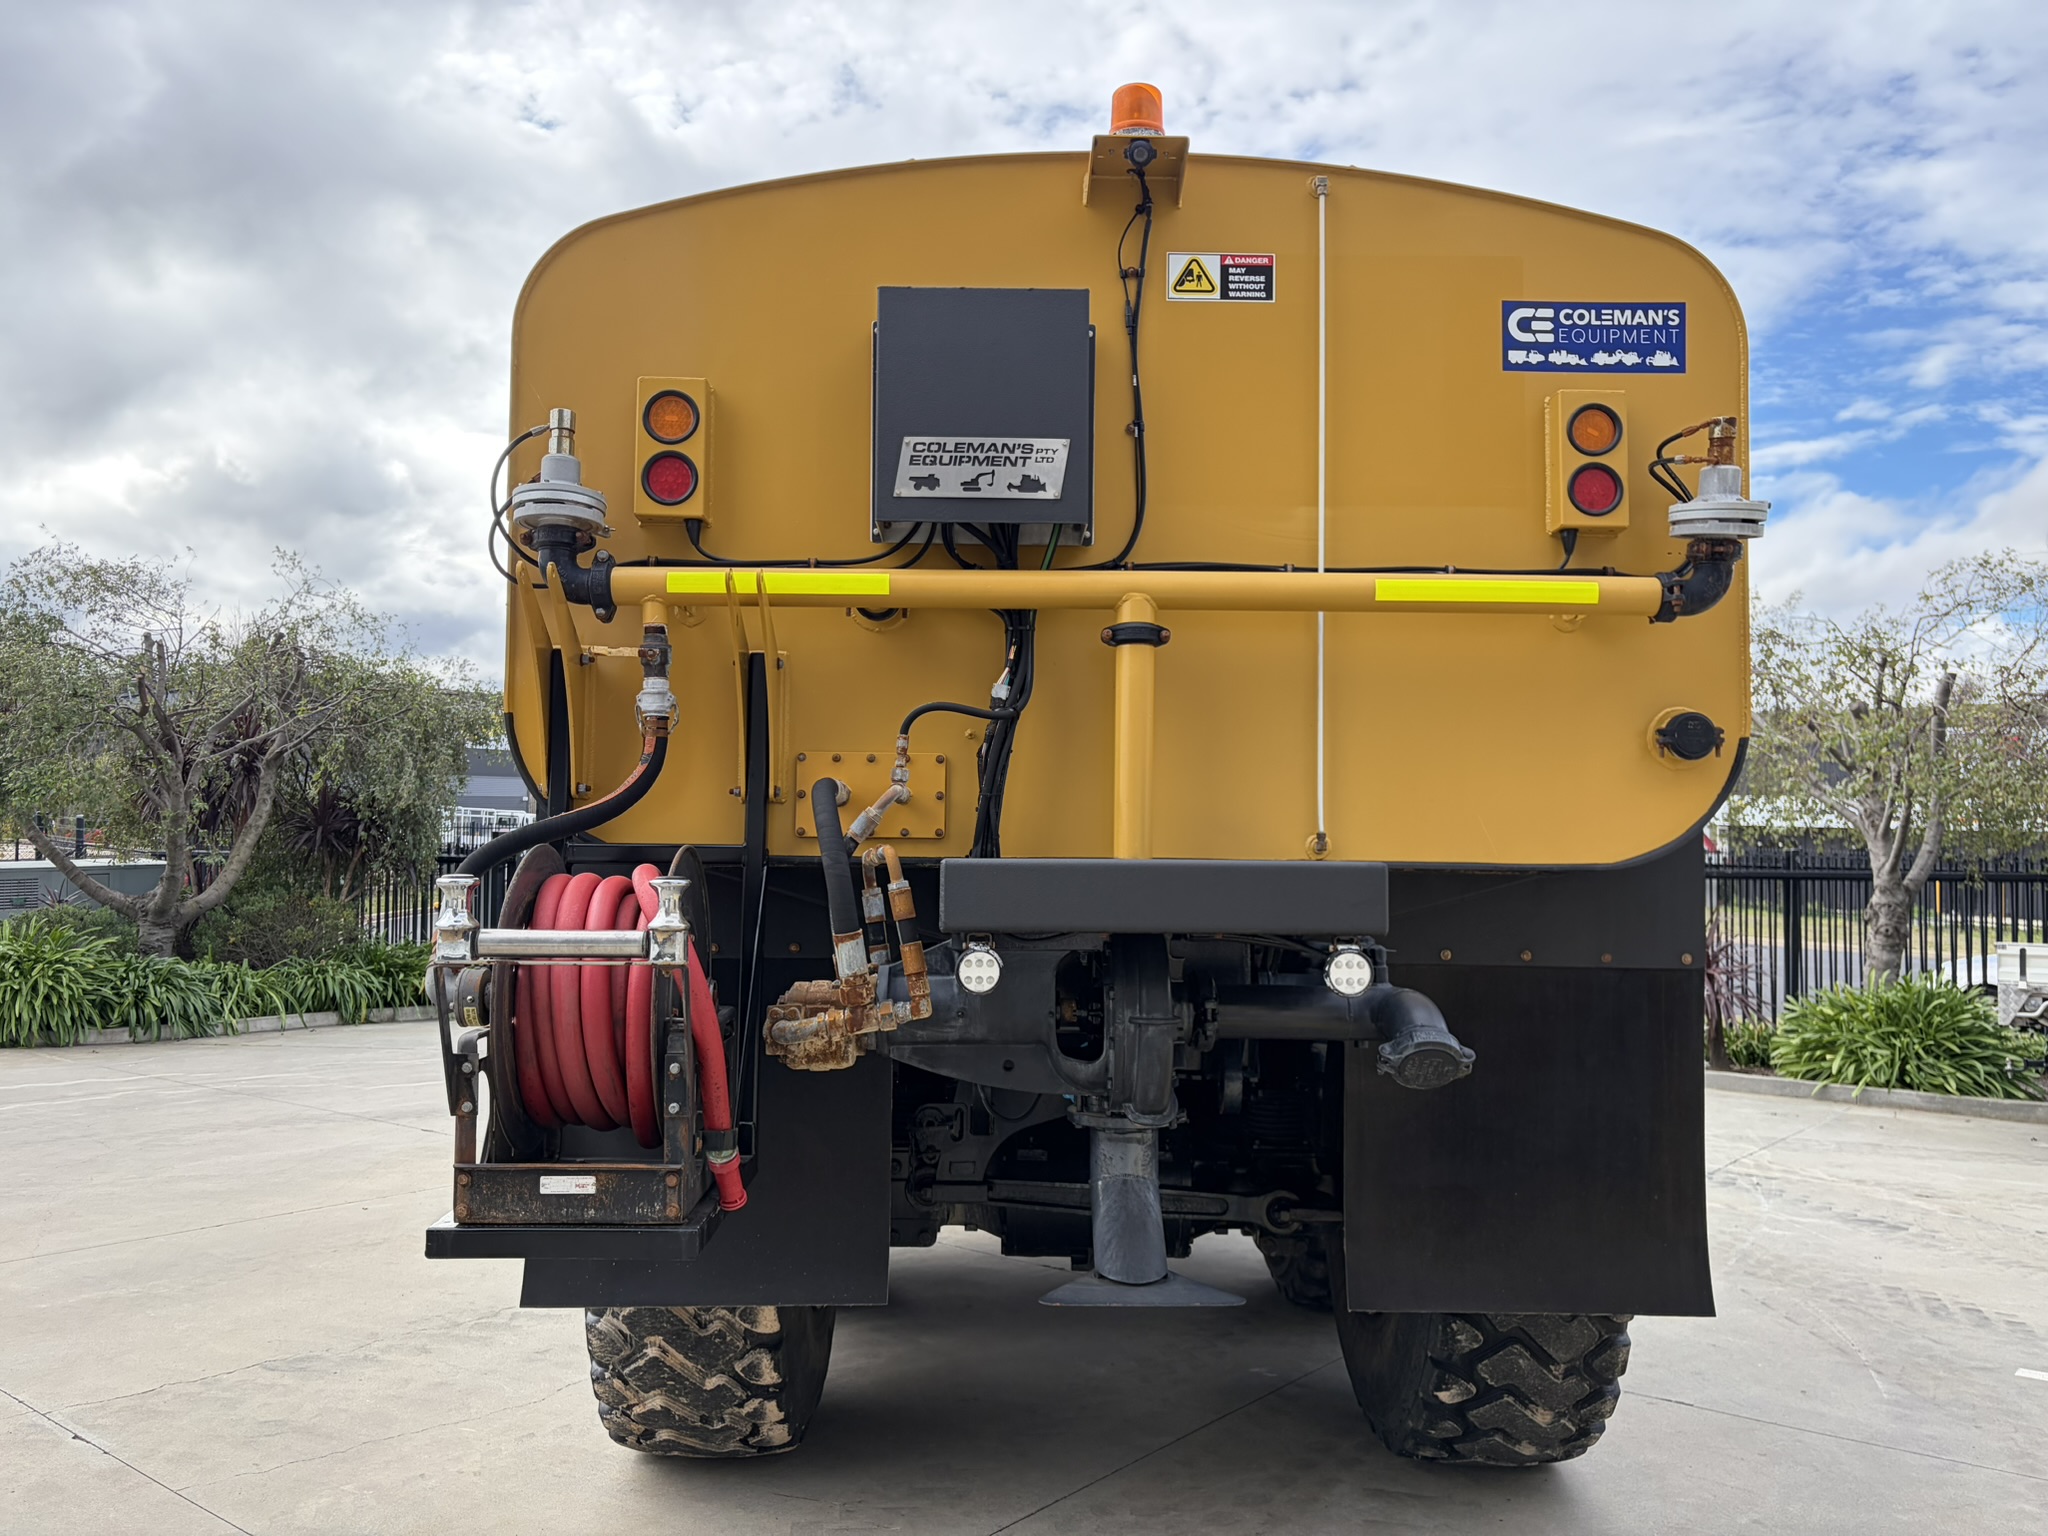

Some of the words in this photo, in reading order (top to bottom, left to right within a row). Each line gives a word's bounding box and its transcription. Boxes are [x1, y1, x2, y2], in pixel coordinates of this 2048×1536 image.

[1559, 308, 1681, 326] COLEMAN'S
[1558, 328, 1680, 344] EQUIPMENT
[912, 442, 1035, 455] COLEMAN'S
[908, 455, 1032, 467] EQUIPMENT
